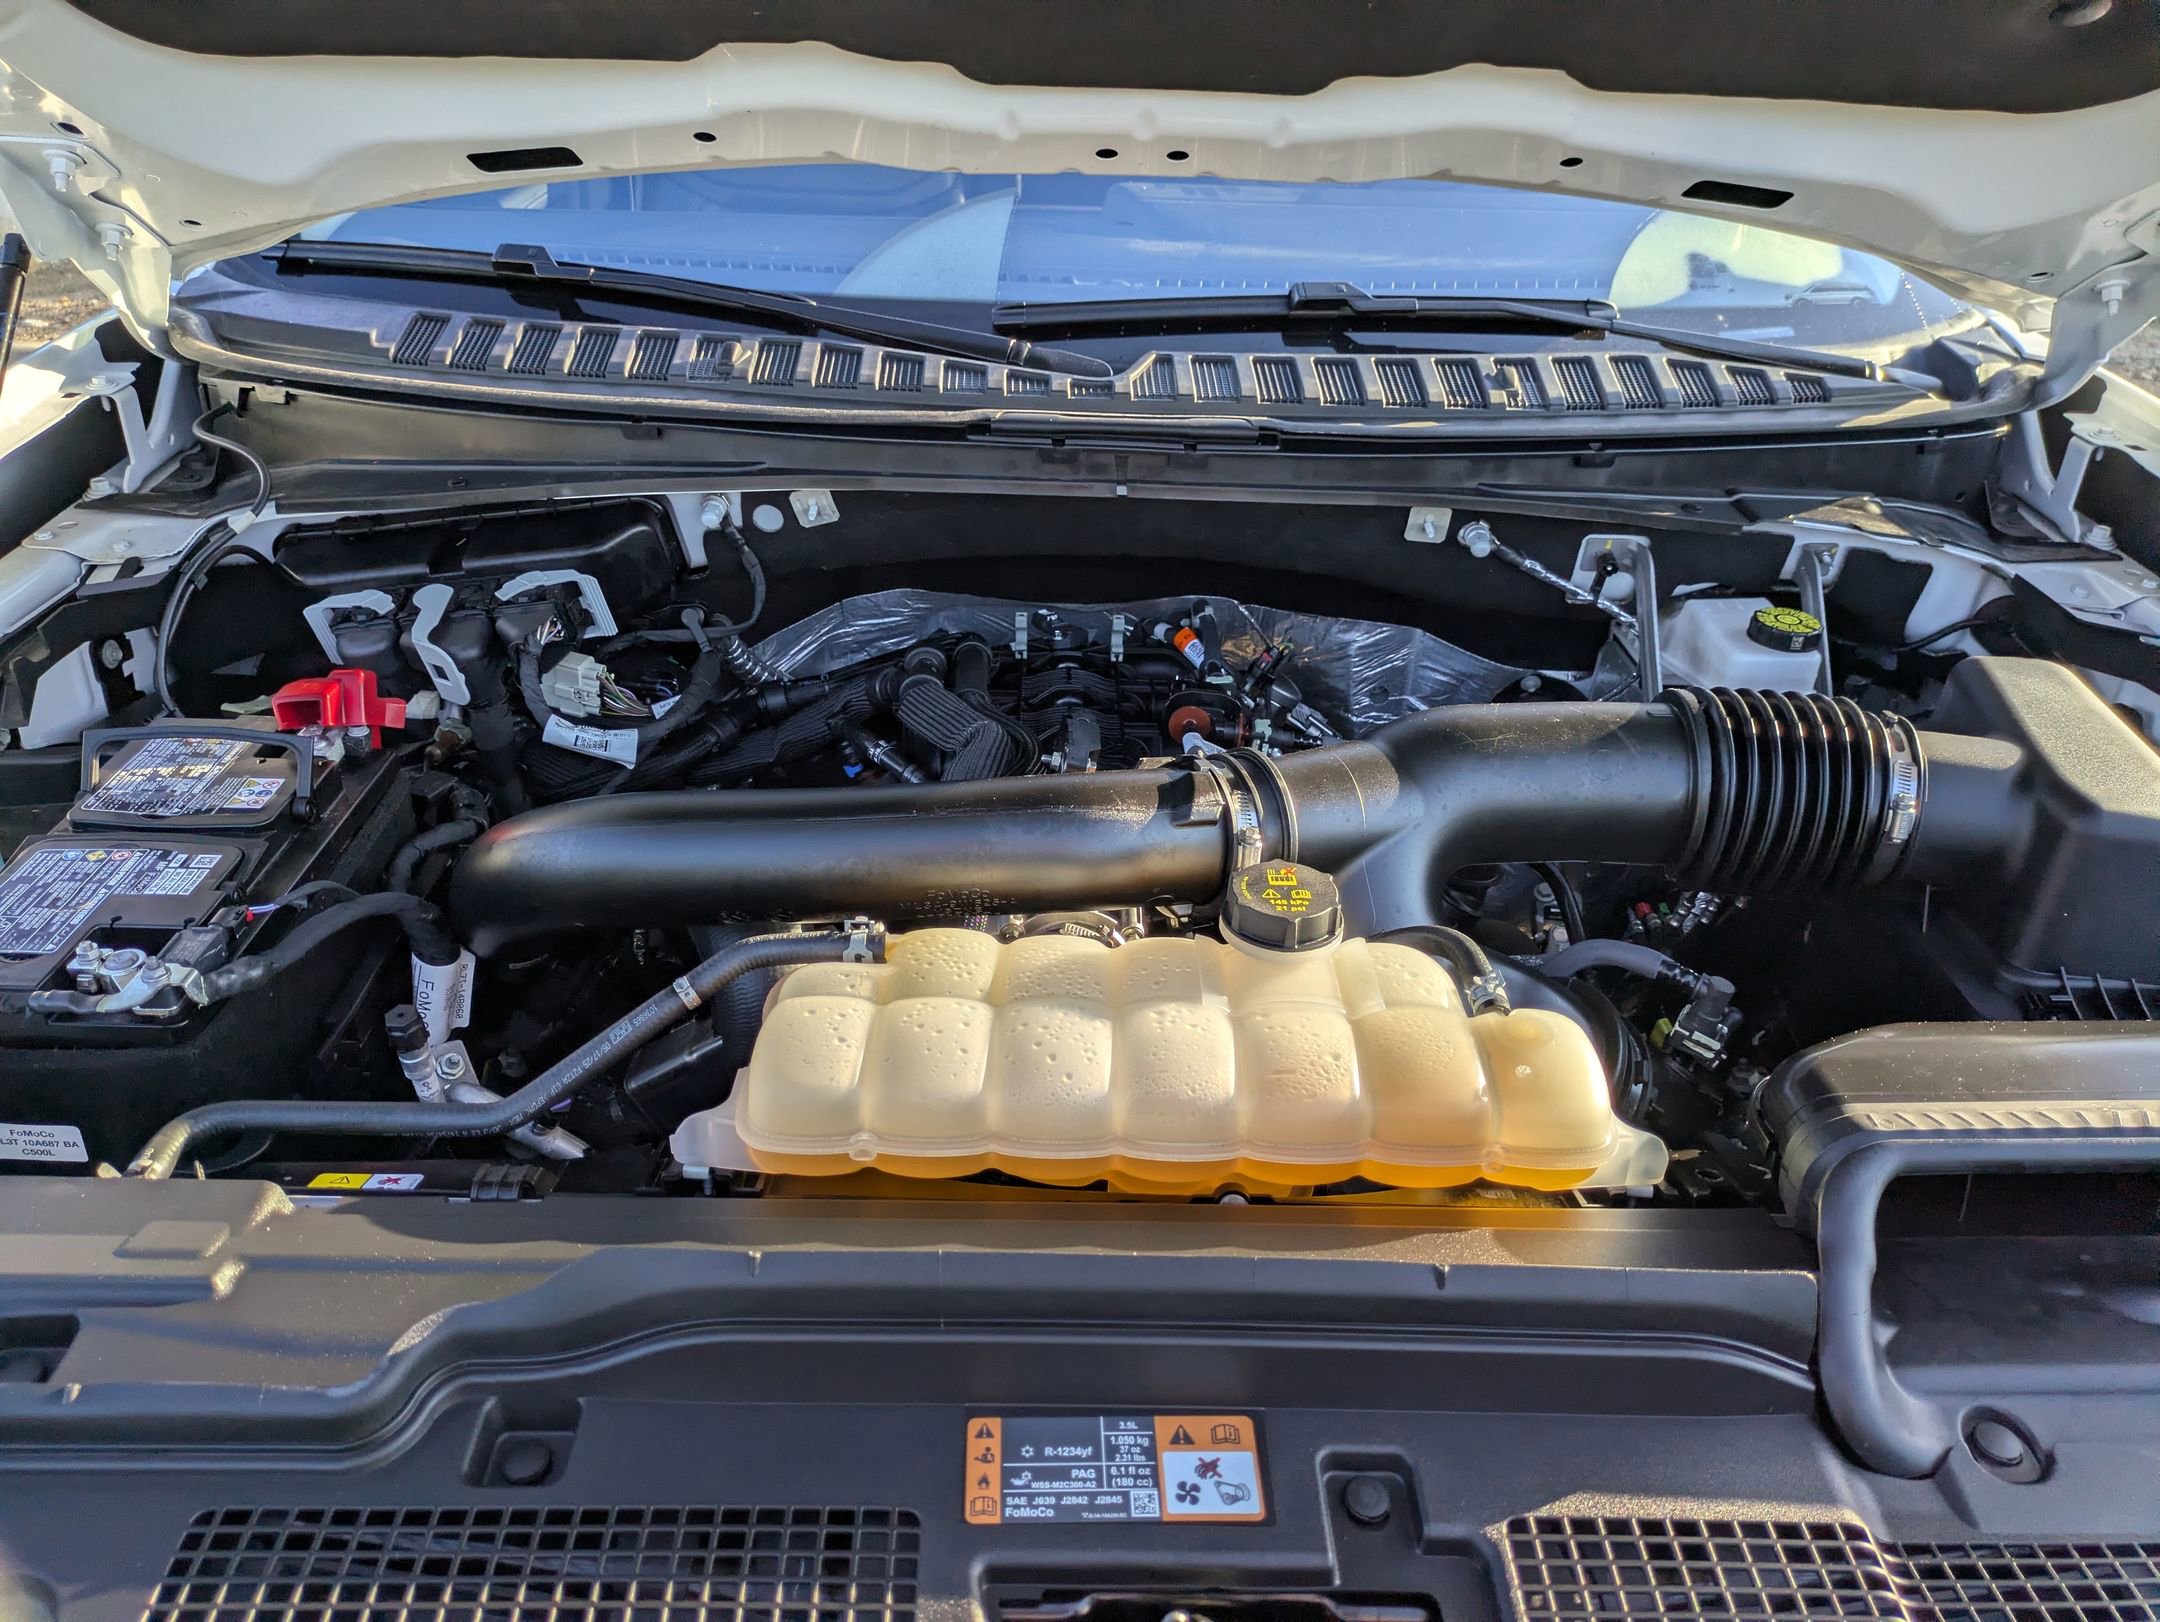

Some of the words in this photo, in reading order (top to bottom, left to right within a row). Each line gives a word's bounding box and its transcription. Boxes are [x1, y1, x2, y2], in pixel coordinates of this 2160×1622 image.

[418, 979, 434, 1032] FoMo
[9, 1129, 55, 1138] FoMoCo
[23, 1139, 60, 1148] 10A687
[22, 1148, 56, 1156] C500L
[1119, 1421, 1138, 1429] 3.5L
[1110, 1436, 1135, 1445] 1.050
[1136, 1435, 1149, 1447] kg
[1044, 1446, 1093, 1458] R-1234yf
[1115, 1454, 1132, 1462] 2.31
[1071, 1469, 1096, 1479] PAG
[1110, 1466, 1125, 1475] 6.1
[1128, 1466, 1136, 1475] fl
[1112, 1477, 1134, 1488] (180
[1136, 1477, 1153, 1487] cc)
[1006, 1497, 1028, 1505] SAE
[1032, 1496, 1056, 1505] J639
[1060, 1495, 1089, 1505] J2842
[1094, 1495, 1123, 1504] J2845
[1005, 1507, 1055, 1517] FoMoCo
